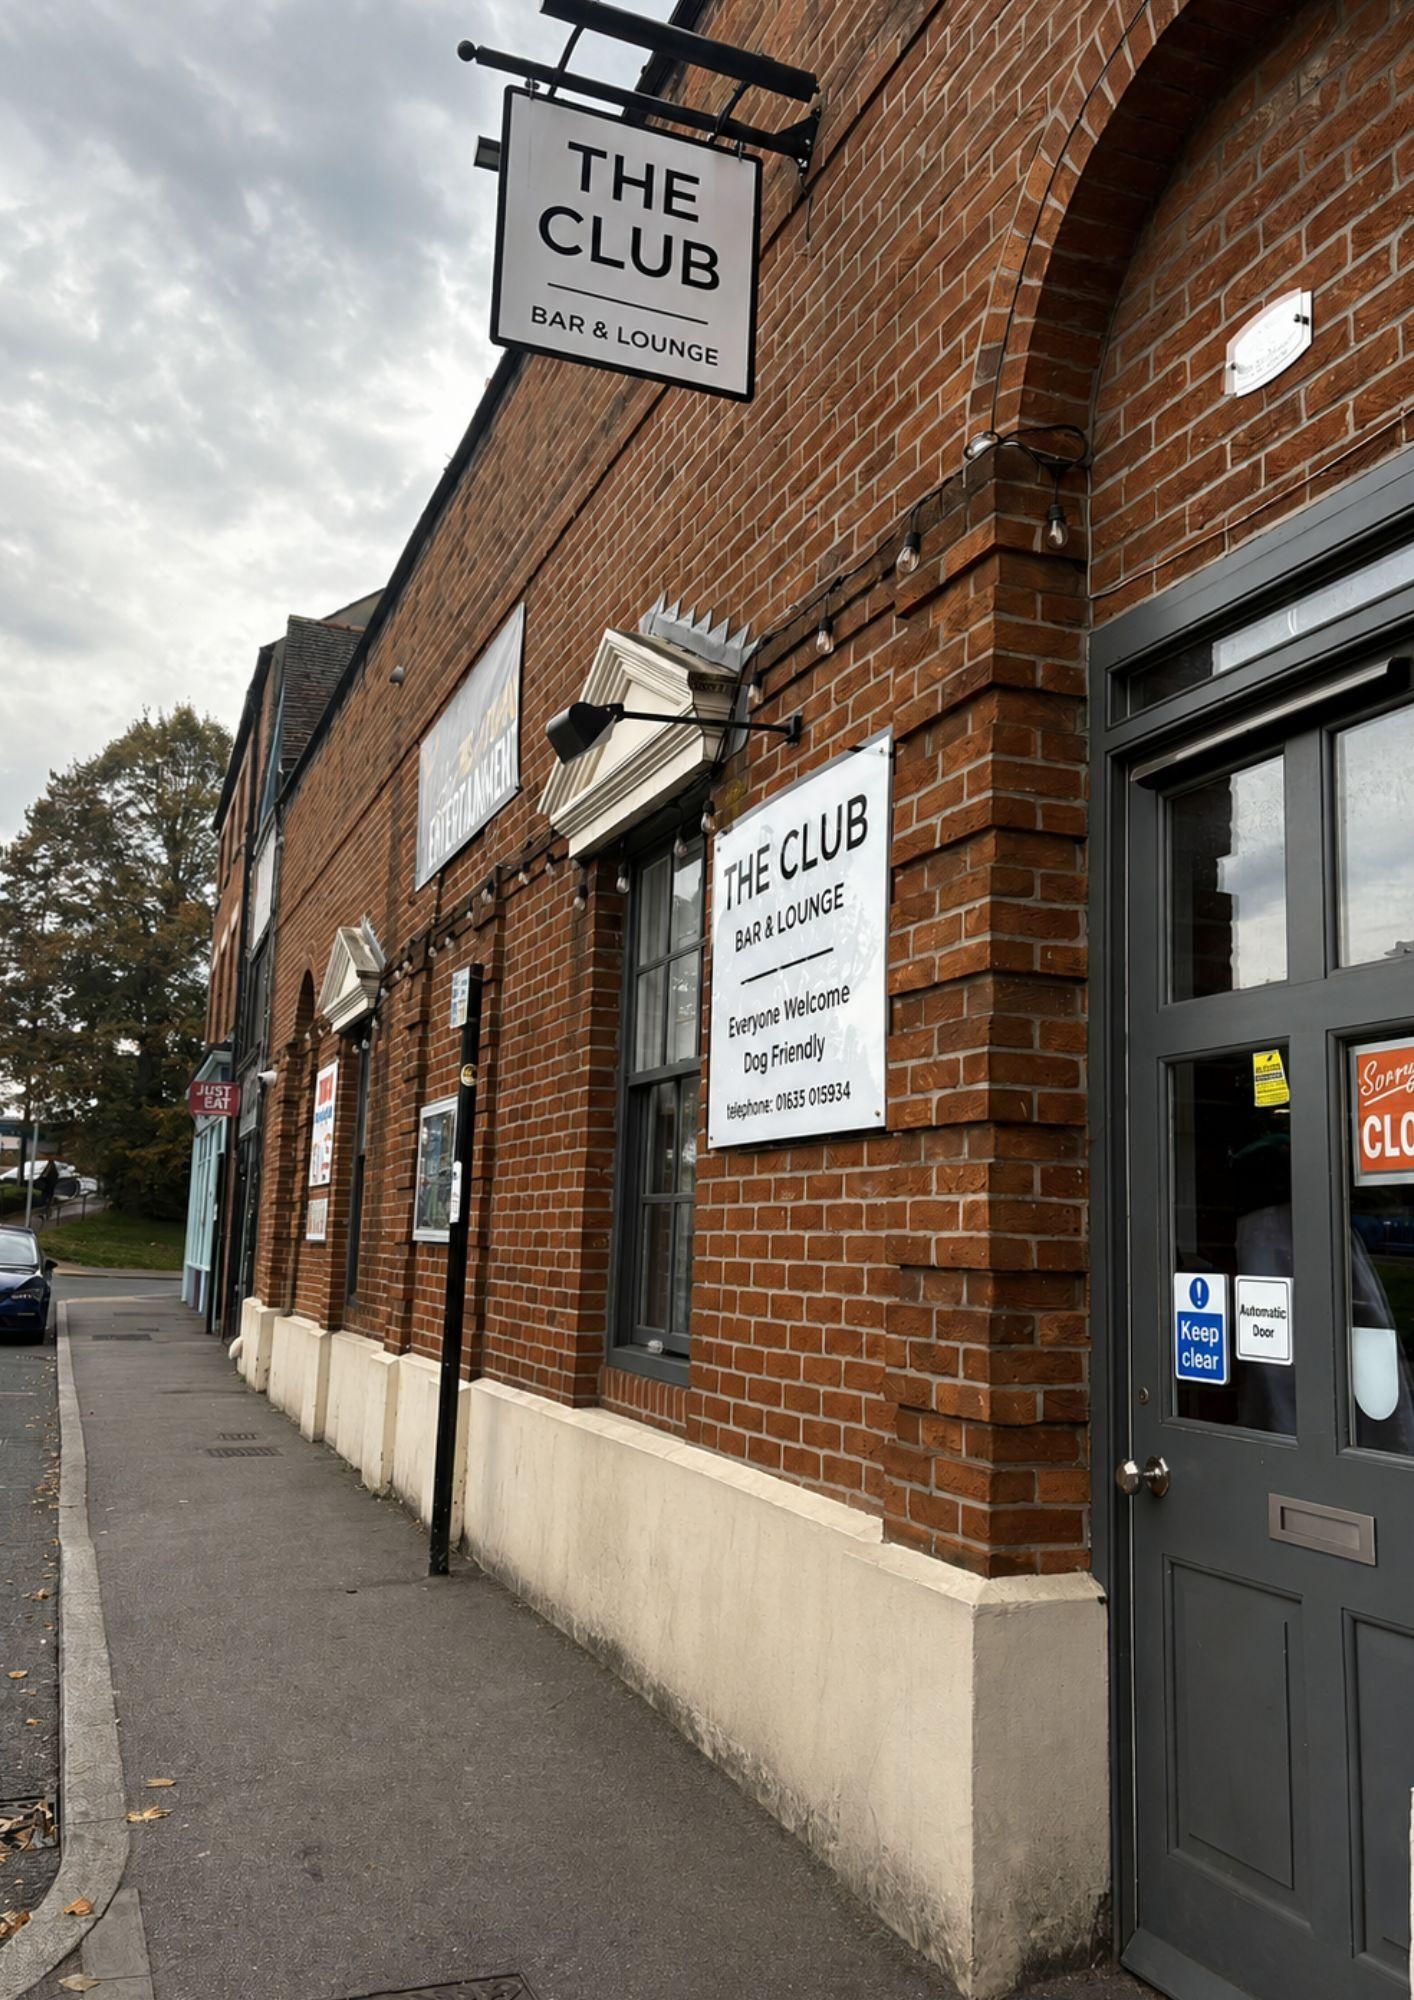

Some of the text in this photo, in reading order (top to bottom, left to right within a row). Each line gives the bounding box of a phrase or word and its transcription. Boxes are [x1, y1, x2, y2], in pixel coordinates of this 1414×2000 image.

[568, 141, 700, 223] THE
[538, 205, 721, 291] CLUB
[531, 306, 719, 367] BAR & LOUNGE
[724, 793, 869, 912] THE CLUB
[734, 883, 845, 953] BAR & LOUNGE
[728, 985, 851, 1038] Everyone Welcome
[744, 1033, 826, 1075] Dog Friendly
[196, 1084, 233, 1098] JUST
[205, 1097, 231, 1109] EAT
[726, 1081, 852, 1121] telephone: 01635 015934
[1240, 1304, 1287, 1320] Automatic
[1252, 1324, 1275, 1338] Door
[1181, 1320, 1219, 1347] Keep
[1182, 1347, 1219, 1370] clear
